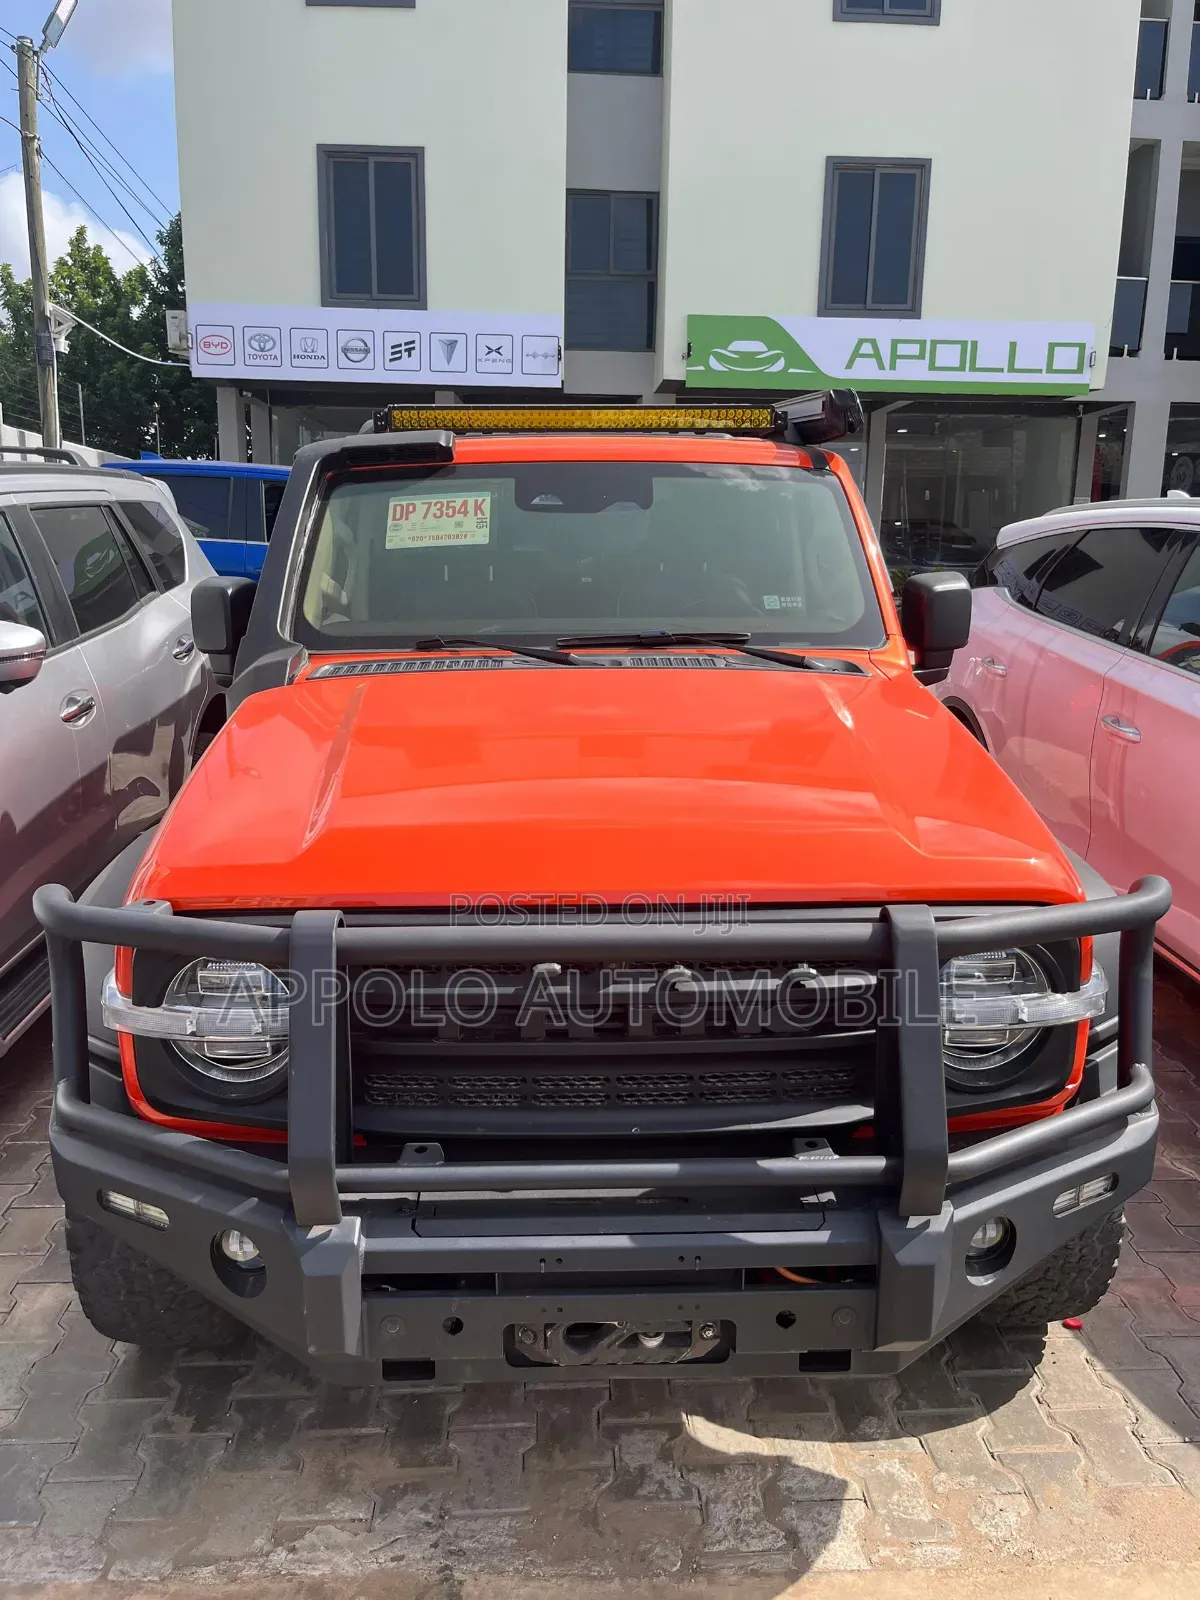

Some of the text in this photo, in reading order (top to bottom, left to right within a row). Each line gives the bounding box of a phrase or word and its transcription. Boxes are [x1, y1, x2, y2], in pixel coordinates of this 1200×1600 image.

[203, 341, 229, 350] BYD
[343, 346, 369, 354] NISSAN
[247, 353, 279, 361] TOYOTA
[292, 353, 326, 361] HONDA
[844, 337, 1087, 375] APOLLO
[391, 498, 487, 522] DP 7354 K
